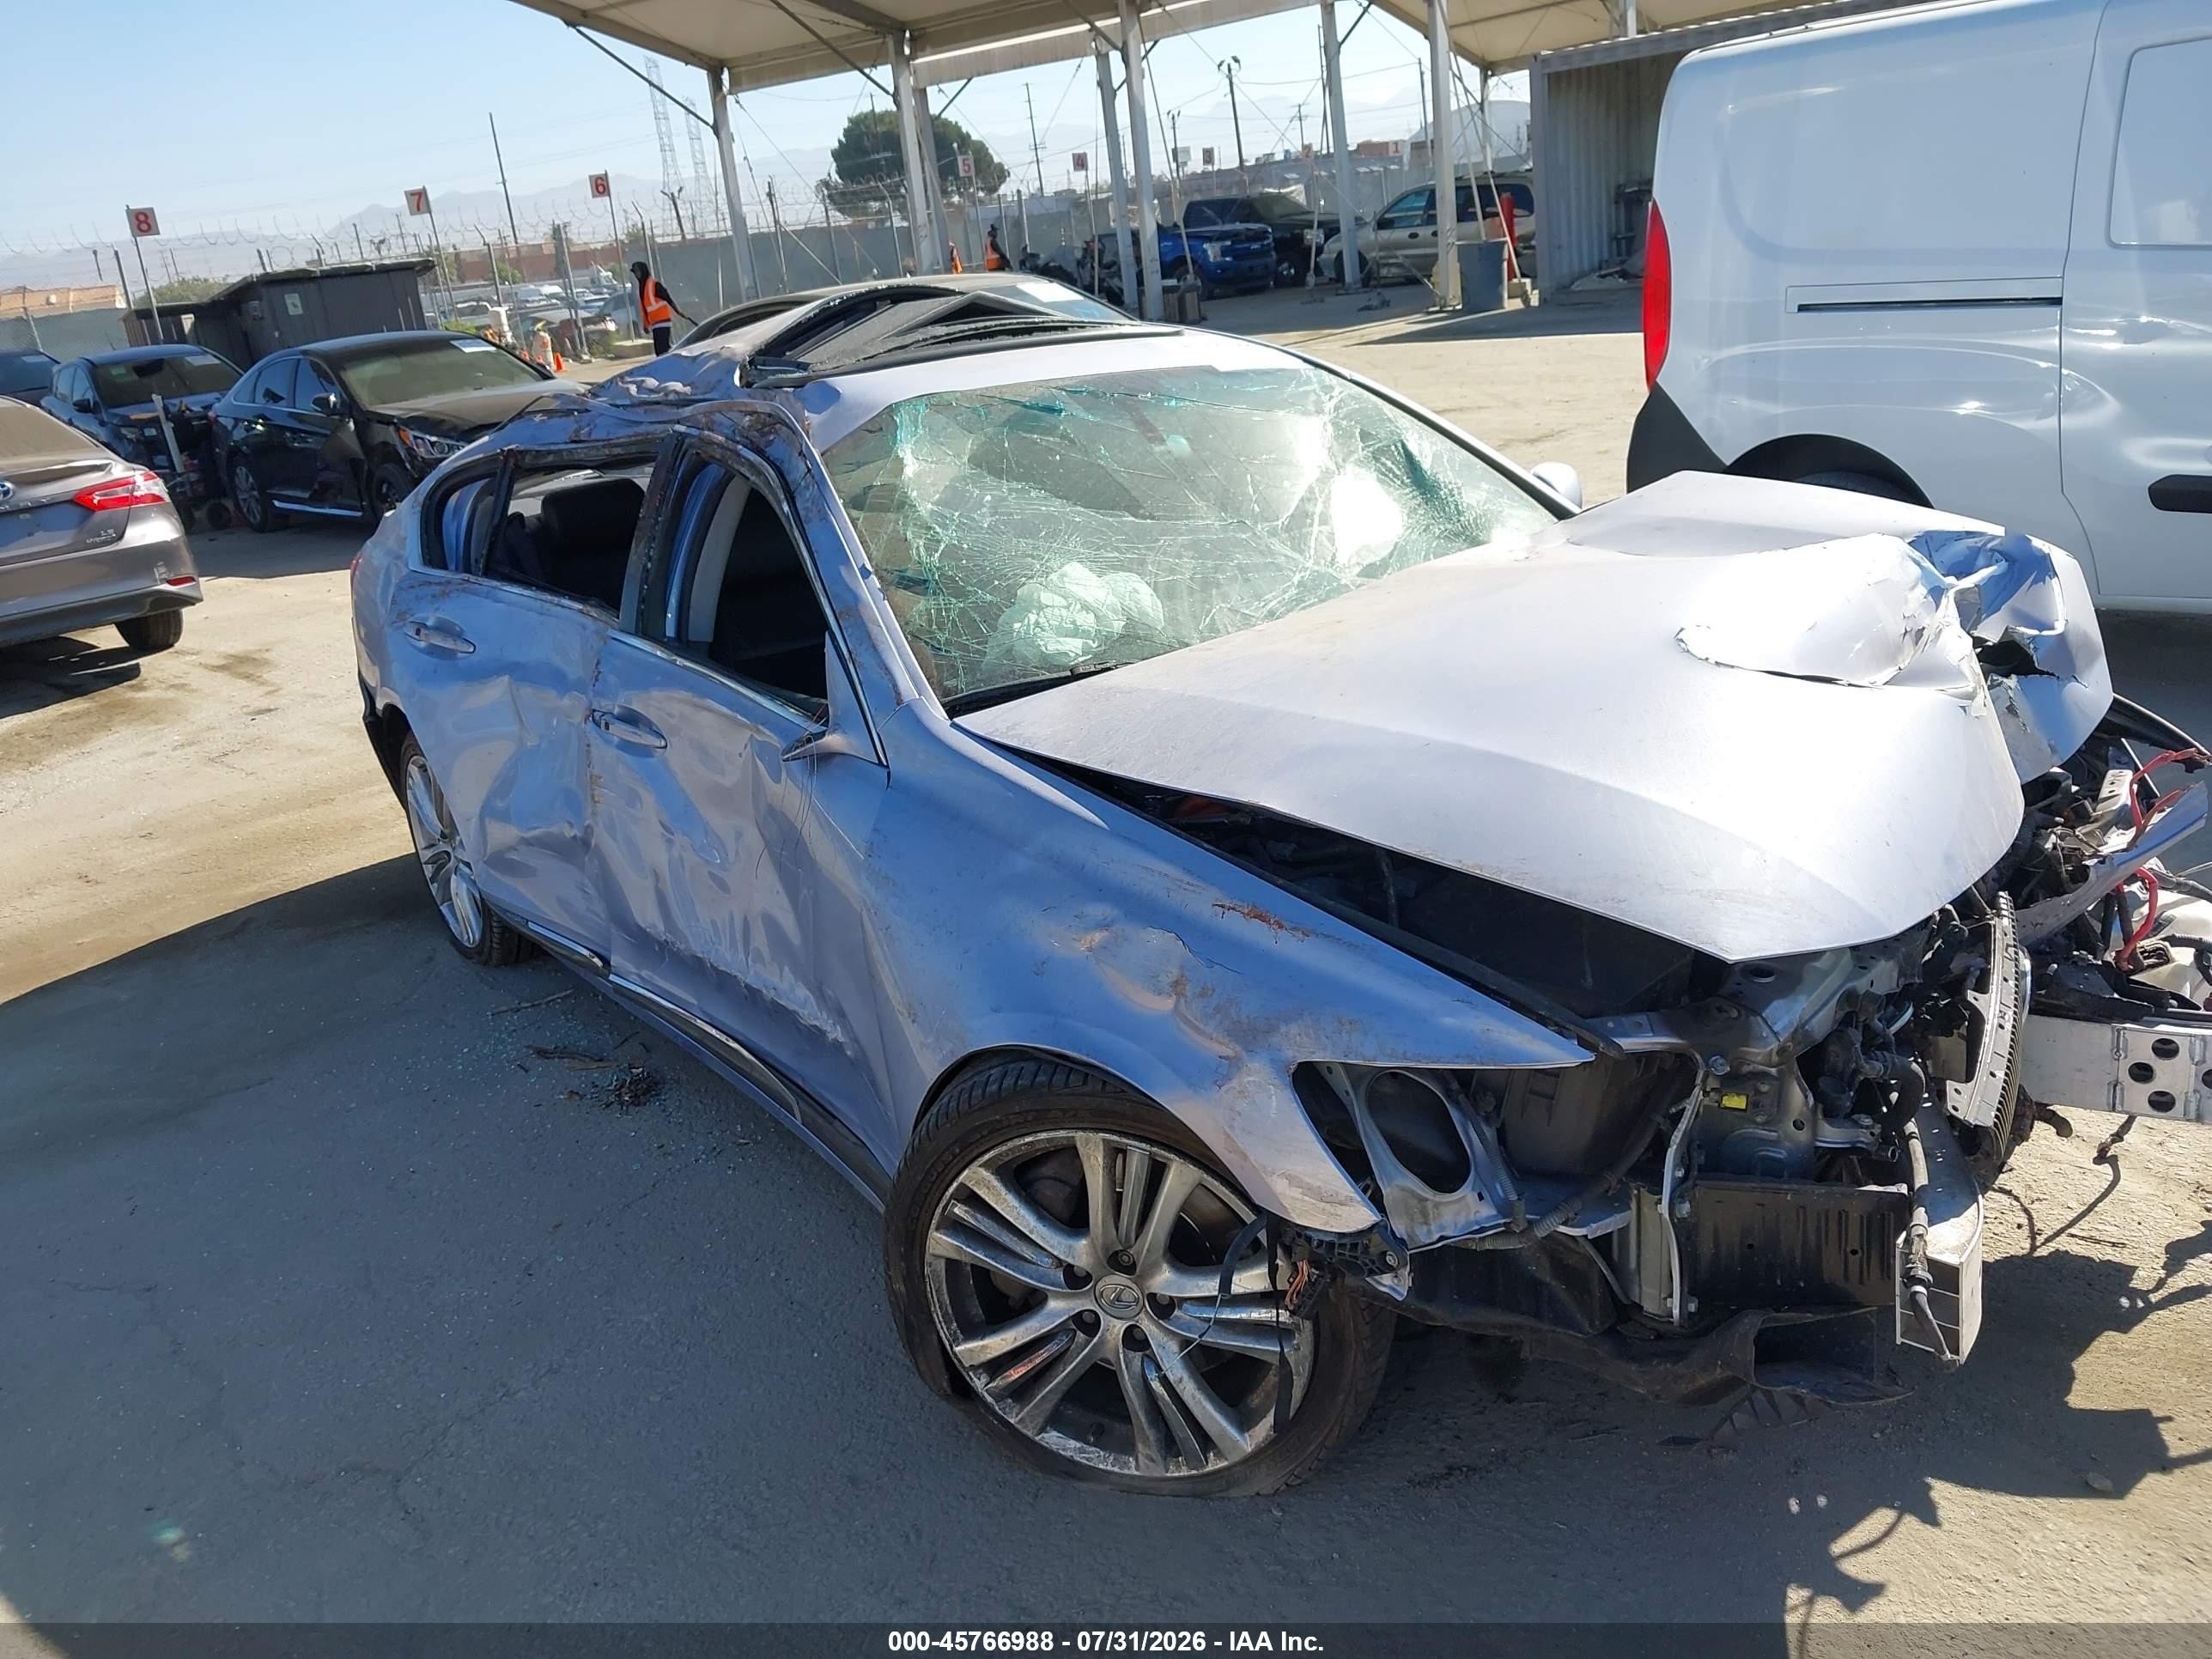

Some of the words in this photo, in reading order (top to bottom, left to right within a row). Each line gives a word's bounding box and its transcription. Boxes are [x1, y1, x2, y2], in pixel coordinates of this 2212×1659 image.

[962, 158, 970, 173] 5
[1076, 155, 1085, 170] 4
[594, 176, 605, 194] 6
[410, 191, 422, 212] 7
[134, 210, 152, 234] 8
